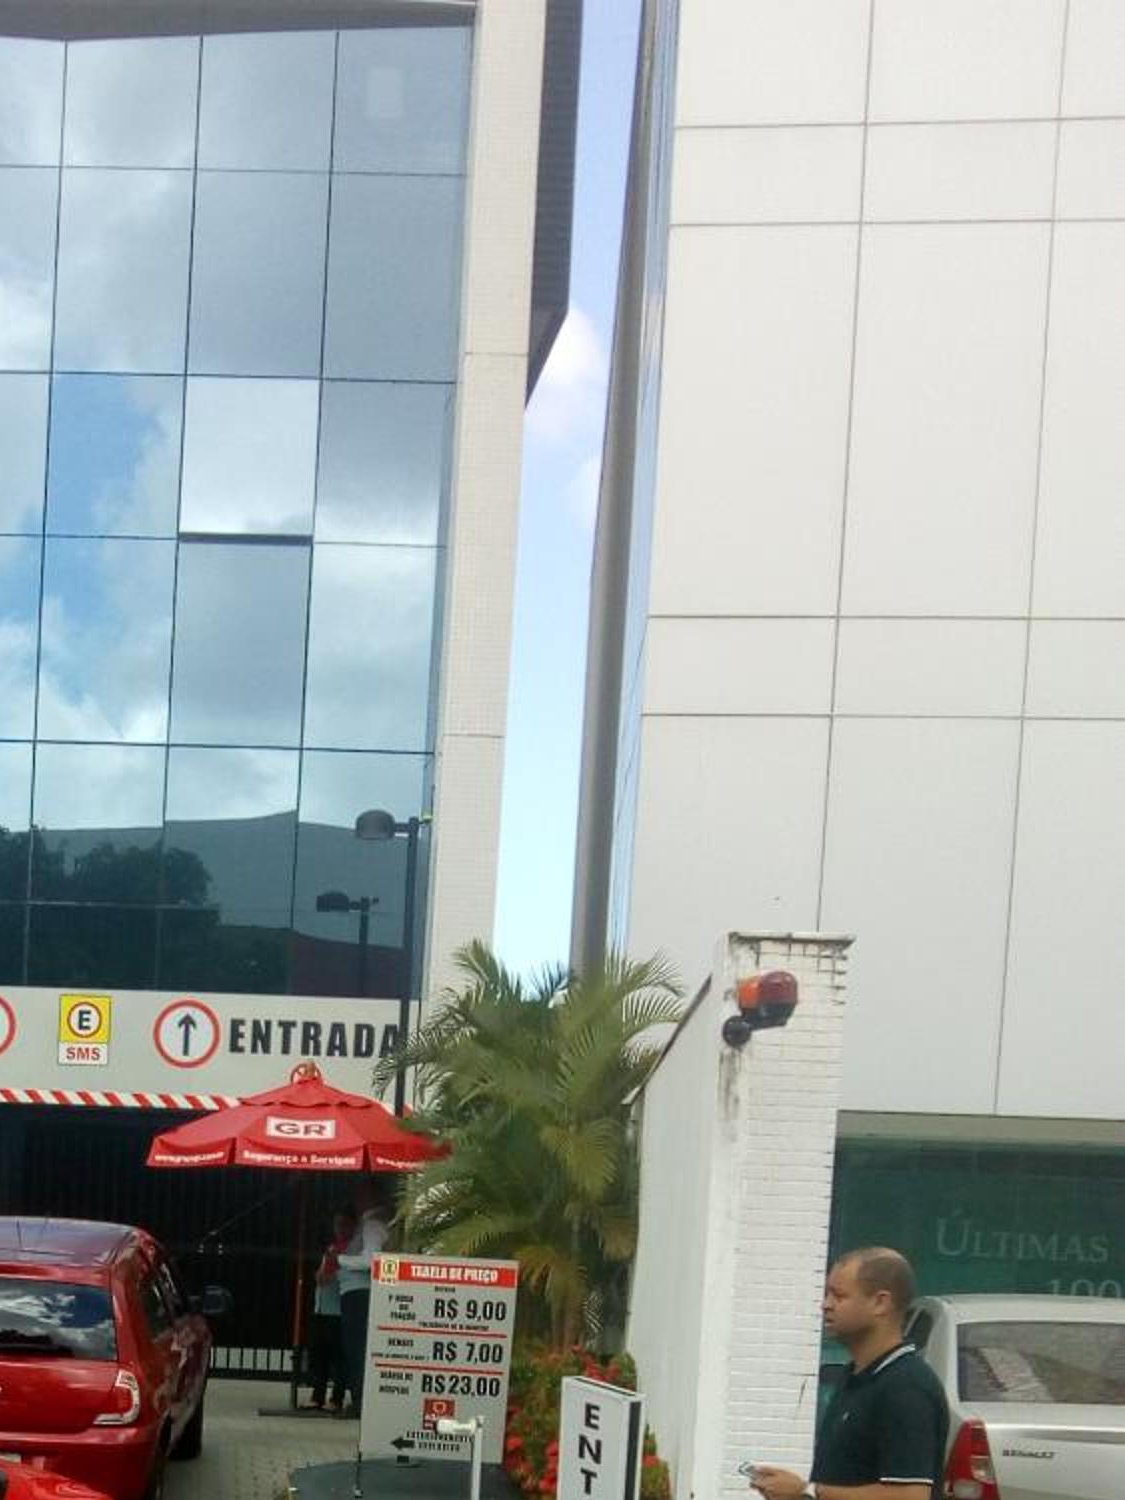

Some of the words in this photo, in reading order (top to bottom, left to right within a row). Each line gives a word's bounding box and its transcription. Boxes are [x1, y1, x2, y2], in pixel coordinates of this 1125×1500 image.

[229, 1018, 400, 1058] ENTRADA
[66, 1046, 101, 1061] SMS
[274, 1121, 327, 1136] GR
[937, 1207, 1109, 1262] ÚLTIMAS
[434, 1298, 459, 1321] R$
[466, 1300, 508, 1322] 9,00
[432, 1341, 457, 1363] R$
[466, 1342, 503, 1364] 7,00
